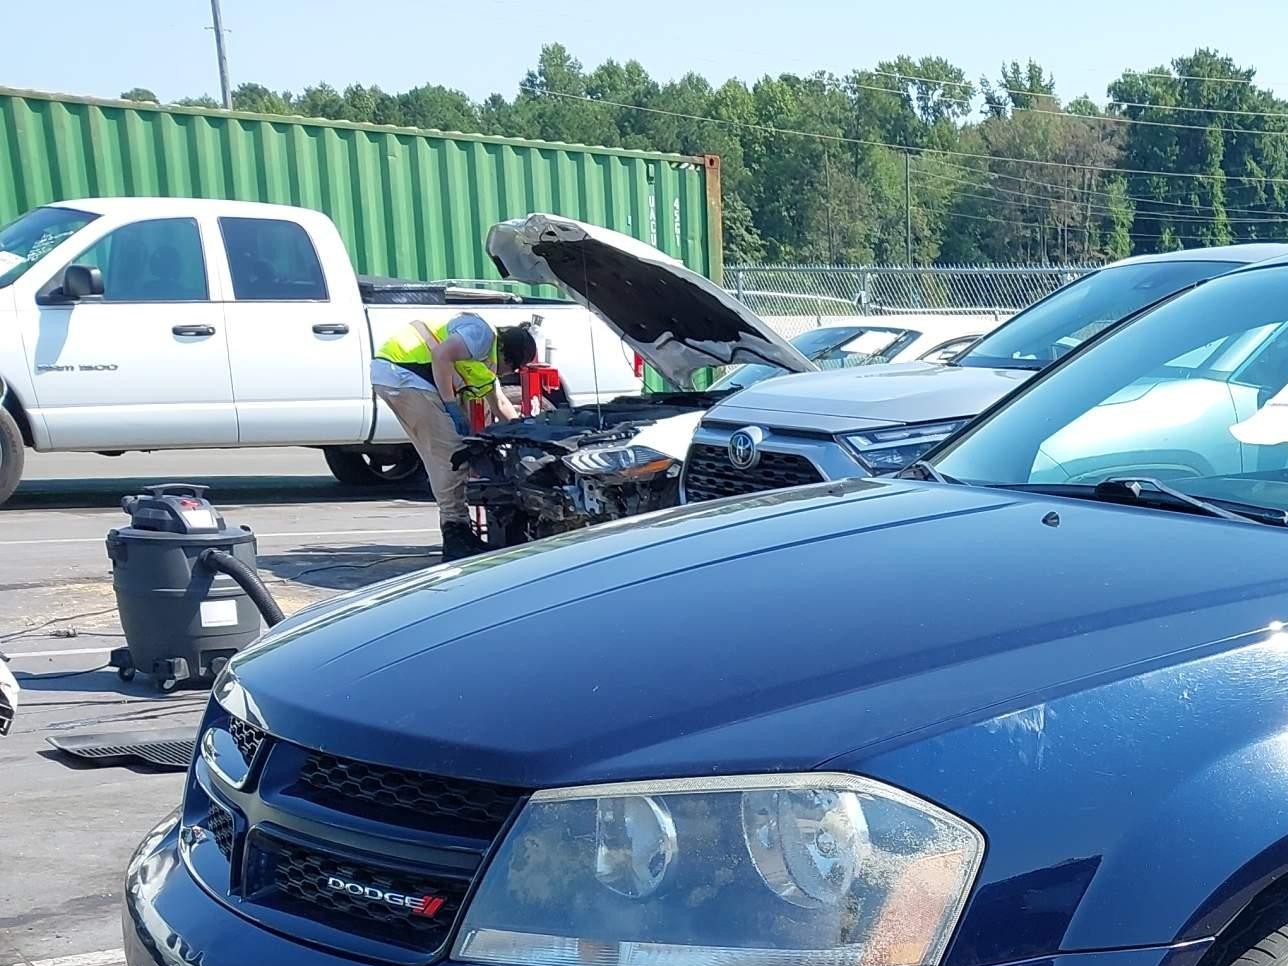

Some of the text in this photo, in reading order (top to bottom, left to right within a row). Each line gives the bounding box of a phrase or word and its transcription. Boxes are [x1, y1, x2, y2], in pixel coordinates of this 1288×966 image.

[648, 195, 657, 247] UACU
[673, 197, 681, 247] 45G1
[327, 877, 426, 910] DODGE
